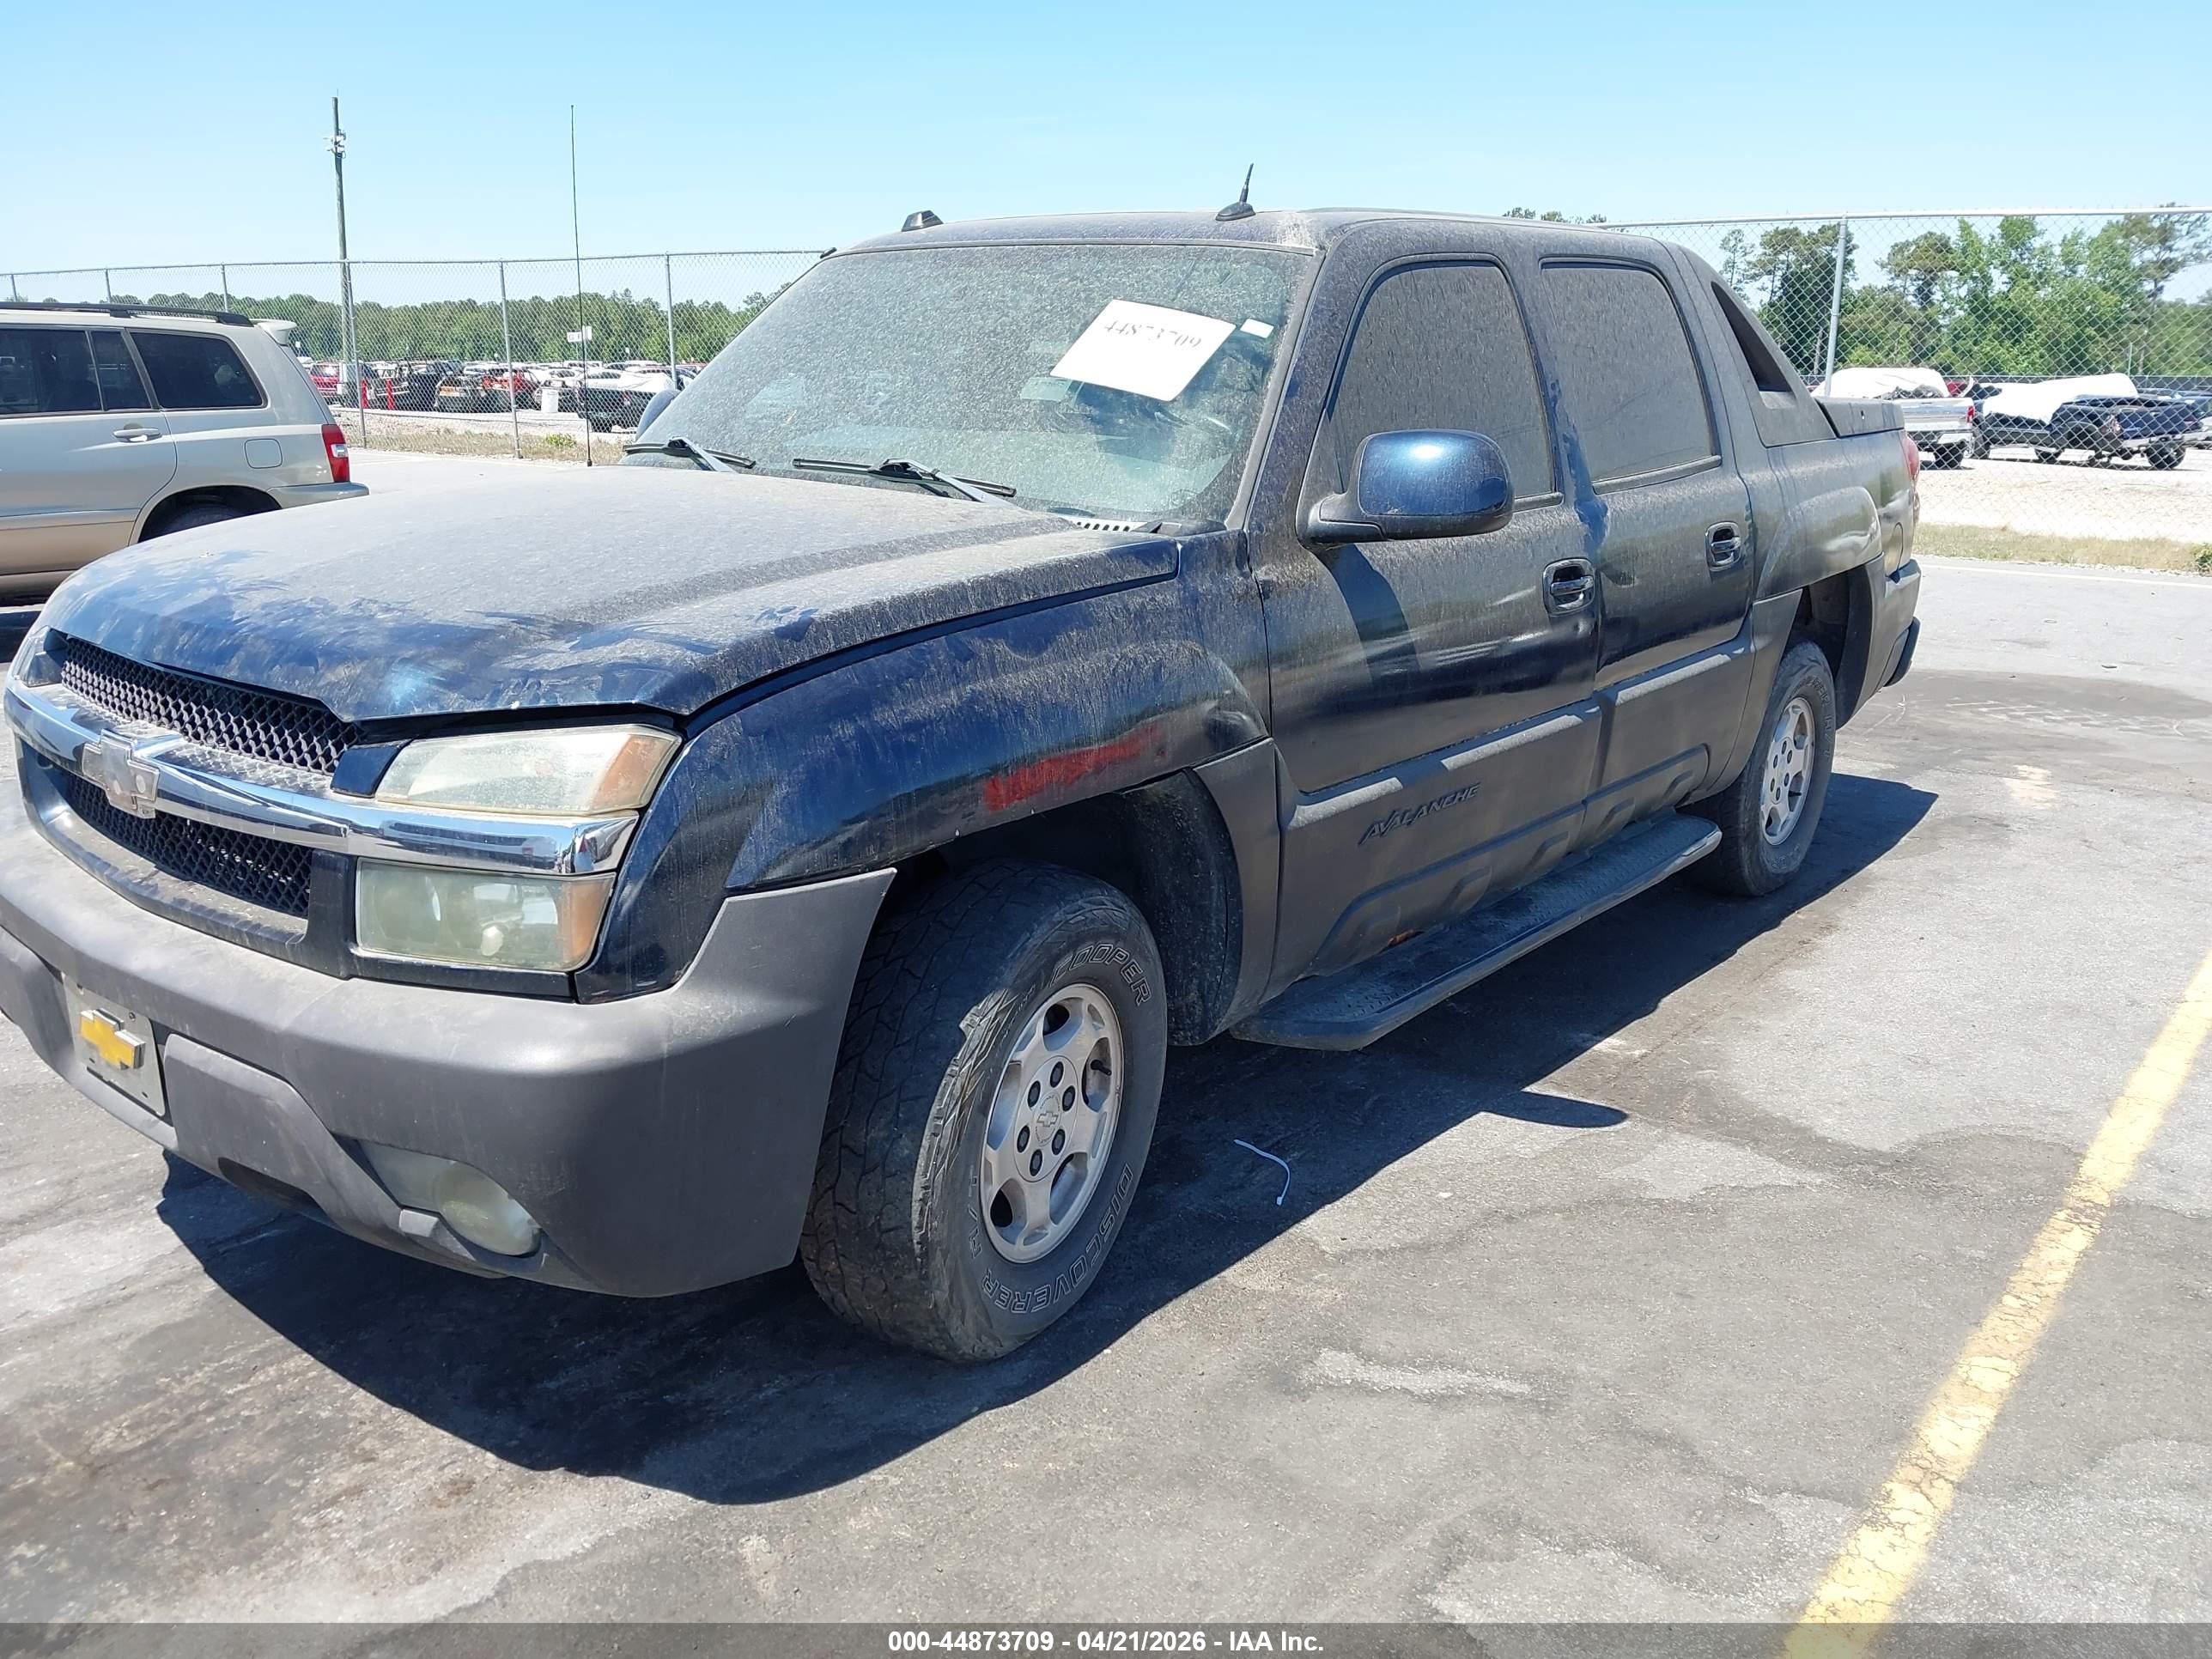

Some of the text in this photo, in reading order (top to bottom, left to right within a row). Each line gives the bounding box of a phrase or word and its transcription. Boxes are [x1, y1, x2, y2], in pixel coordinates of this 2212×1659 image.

[1358, 781, 1482, 846] AVALANCHE
[1048, 943, 1152, 1007] COOPER
[981, 1162, 1134, 1315] DISCOVERER
